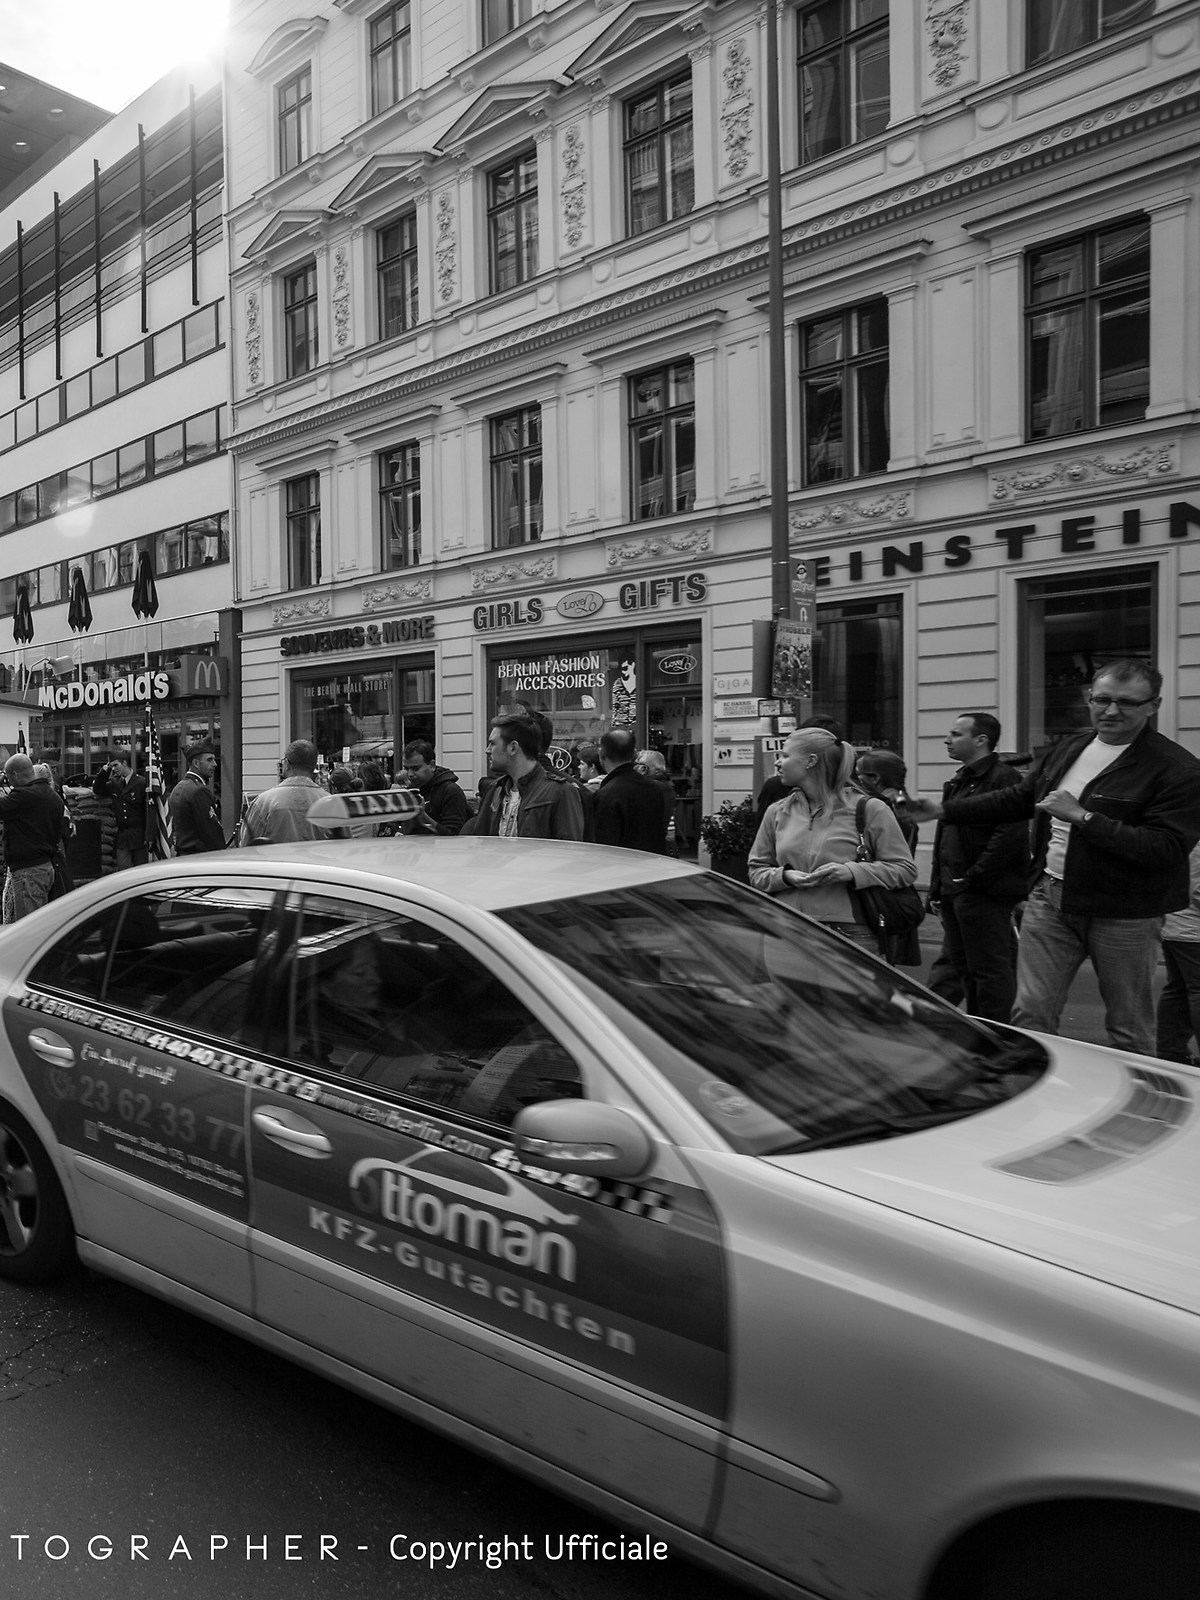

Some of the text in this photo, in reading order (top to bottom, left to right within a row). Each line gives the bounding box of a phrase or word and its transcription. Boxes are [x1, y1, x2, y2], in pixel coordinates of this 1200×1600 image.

[472, 597, 544, 632] GIRLS
[619, 572, 709, 612] GIFTS
[367, 624, 382, 645] &
[382, 615, 435, 644] MORE
[498, 655, 600, 679] BERLIN FASHION
[38, 671, 170, 711] McDonald's
[515, 673, 606, 692] ACCESSOIRES
[348, 793, 410, 815] TAXI
[80, 1075, 110, 1113] 23
[118, 1088, 150, 1127] 62
[160, 1102, 196, 1143] 33
[205, 1115, 245, 1159] 77
